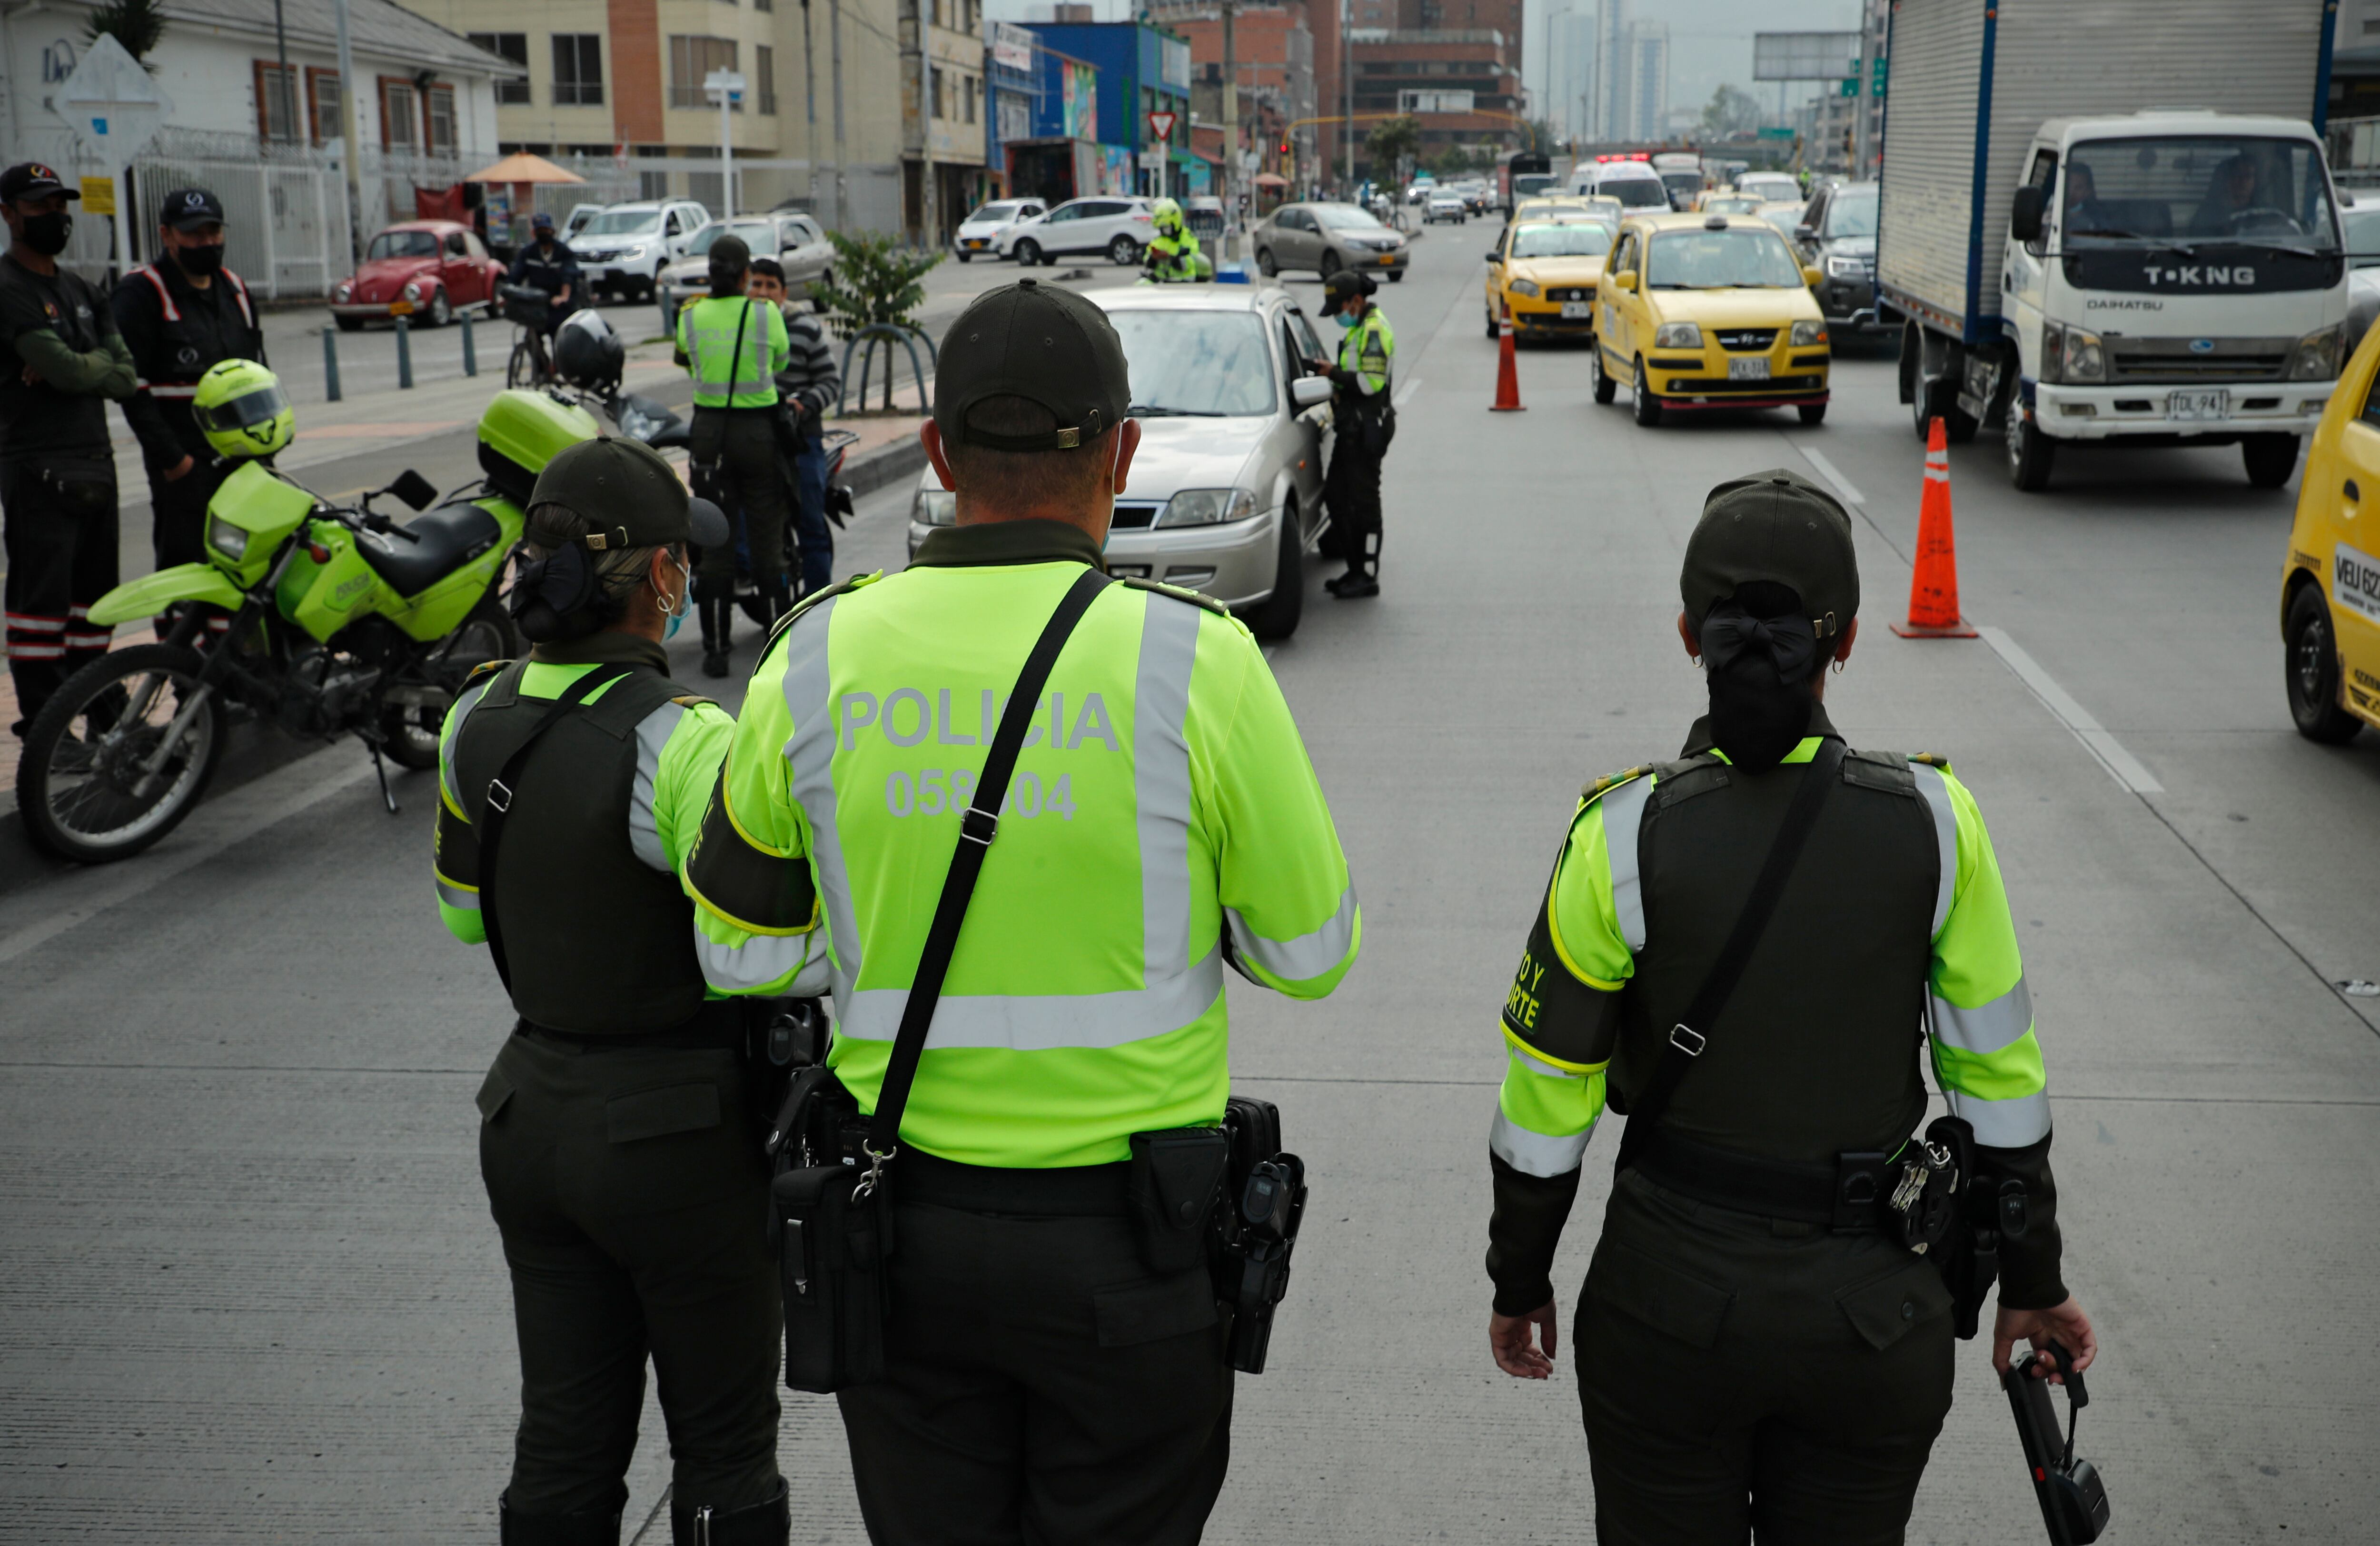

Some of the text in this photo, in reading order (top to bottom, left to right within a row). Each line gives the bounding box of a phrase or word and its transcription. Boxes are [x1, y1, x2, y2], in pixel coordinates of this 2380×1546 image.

[2086, 299, 2164, 312] DAIHATSU
[2362, 567, 2380, 602] 62
[885, 768, 1077, 821] 05804
[1531, 962, 1545, 992] Y
